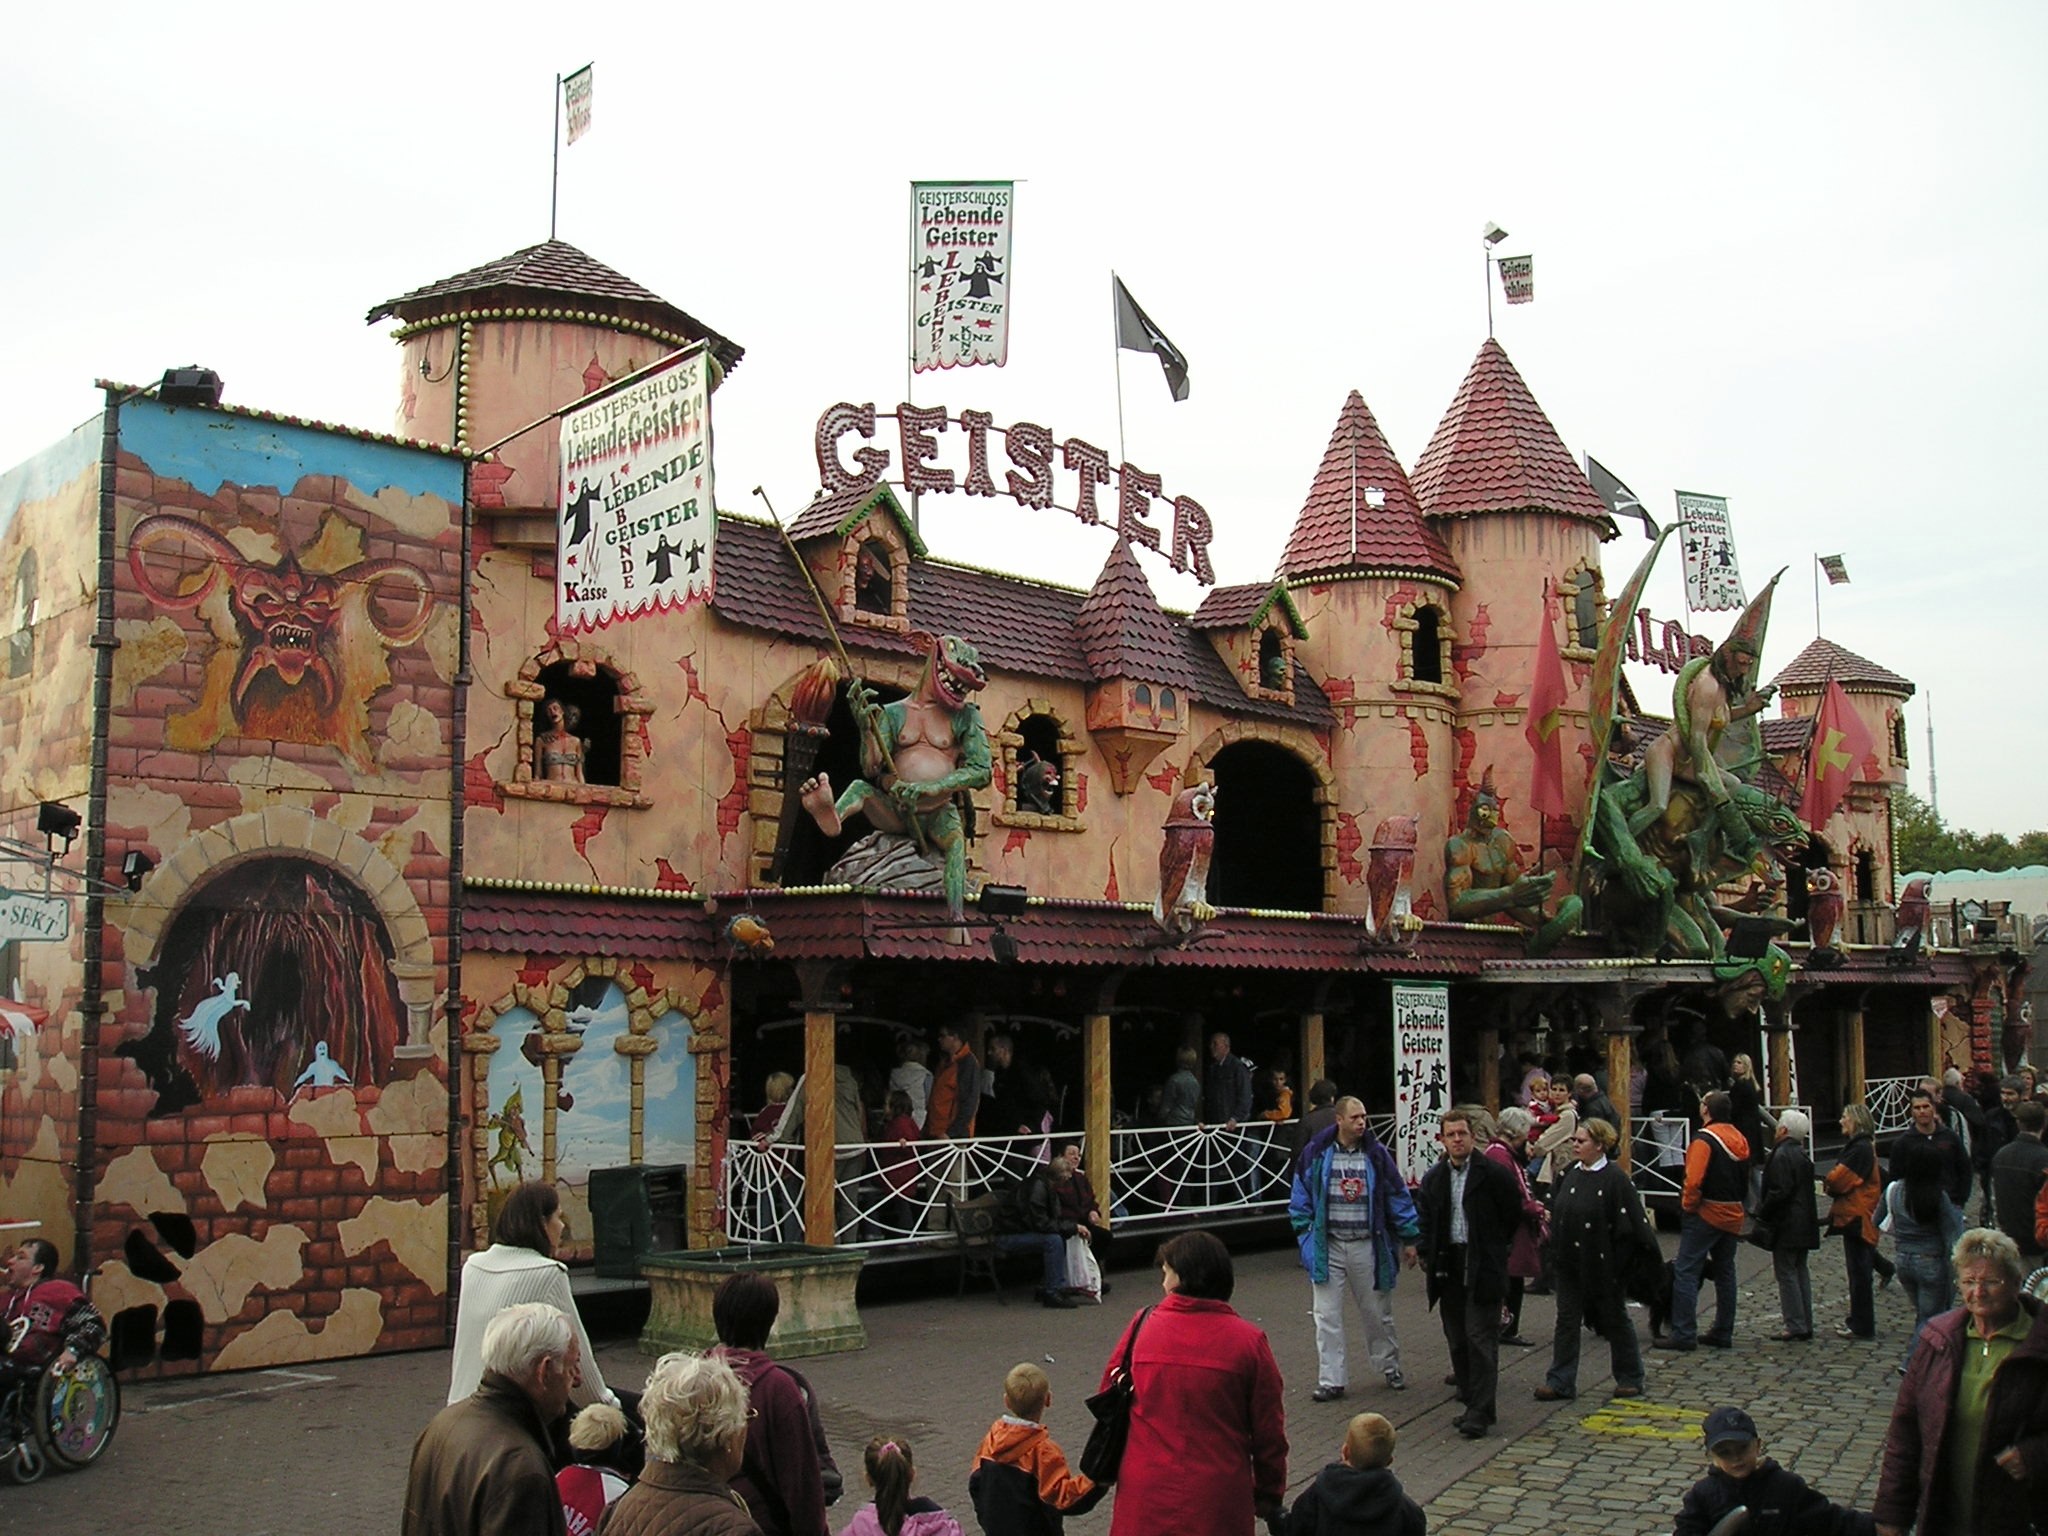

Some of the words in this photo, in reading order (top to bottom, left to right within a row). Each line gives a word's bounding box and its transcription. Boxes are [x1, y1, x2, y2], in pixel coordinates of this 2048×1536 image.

[919, 191, 1008, 207] GEISTERSCHLOSS
[921, 206, 1004, 227] Lebende
[926, 227, 999, 248] Geister
[917, 299, 1003, 328] GEISTER
[932, 251, 961, 352] LEBENDE
[571, 364, 699, 435] GEISTERSCHLOSS
[626, 392, 704, 448] Geister
[567, 420, 626, 471] Lebende
[604, 441, 705, 513] LEBENDE
[815, 402, 1216, 587] GEISTER
[605, 498, 700, 546] GEISTER
[1684, 506, 1726, 523] Lebende
[1689, 520, 1726, 536] Geister
[609, 471, 634, 590] LEBENDE
[564, 581, 608, 603] Kasse
[10, 904, 58, 936] SEKT
[1395, 992, 1446, 1010] GEISTERSCHLOSS
[1398, 1008, 1445, 1031] Lebende
[1402, 1032, 1443, 1055] Geister
[1399, 1112, 1442, 1140] GEISTE
[1408, 1059, 1424, 1167] LEBENDE
